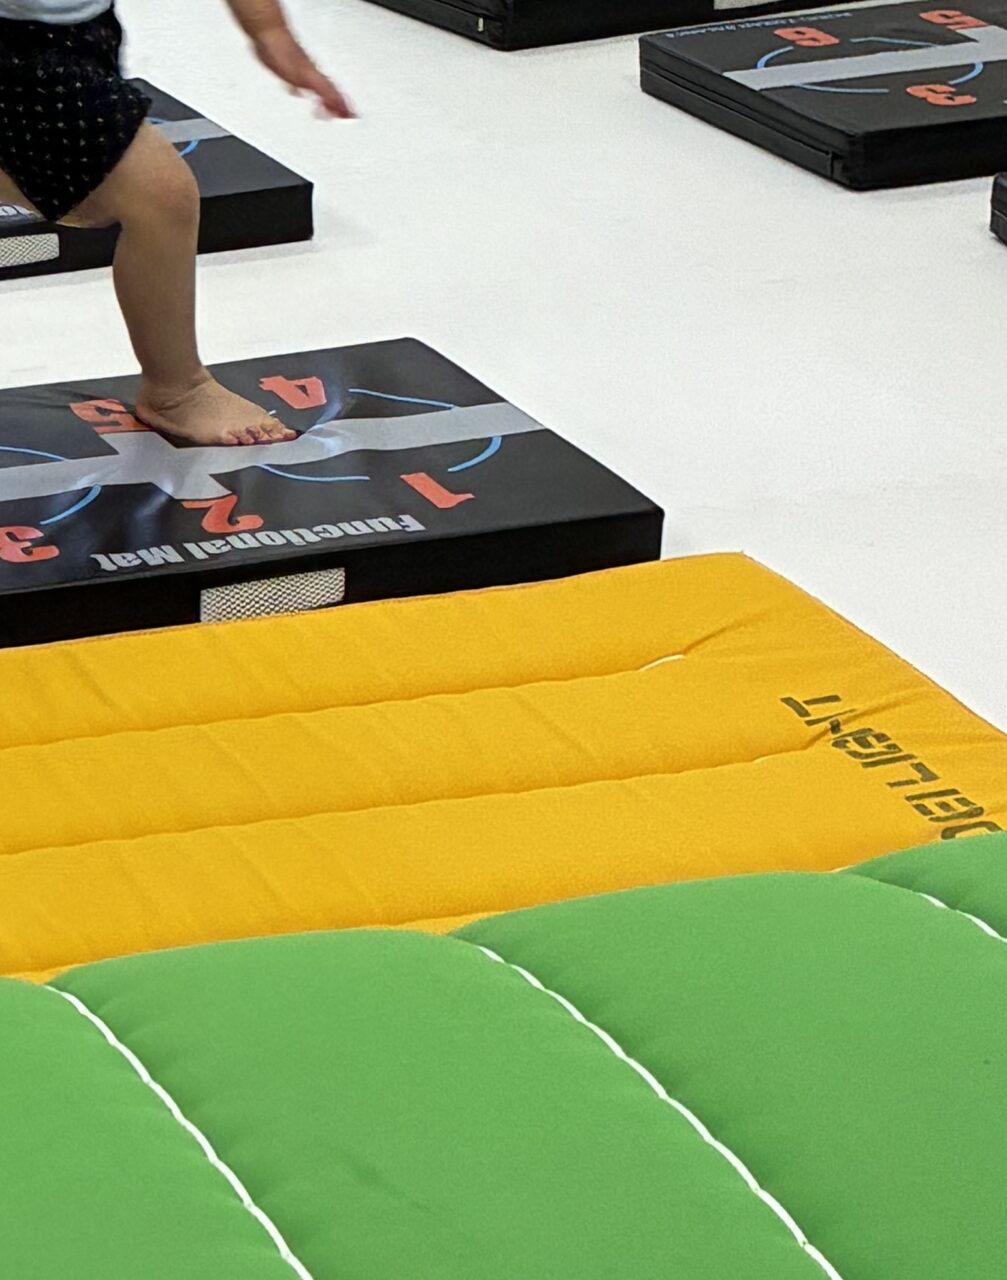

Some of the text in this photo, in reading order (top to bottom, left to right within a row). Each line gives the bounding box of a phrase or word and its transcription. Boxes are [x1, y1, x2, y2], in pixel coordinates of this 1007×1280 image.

[258, 375, 327, 410] 4
[400, 472, 475, 509] 1
[181, 494, 264, 534] 2
[89, 513, 427, 571] Functional Mat
